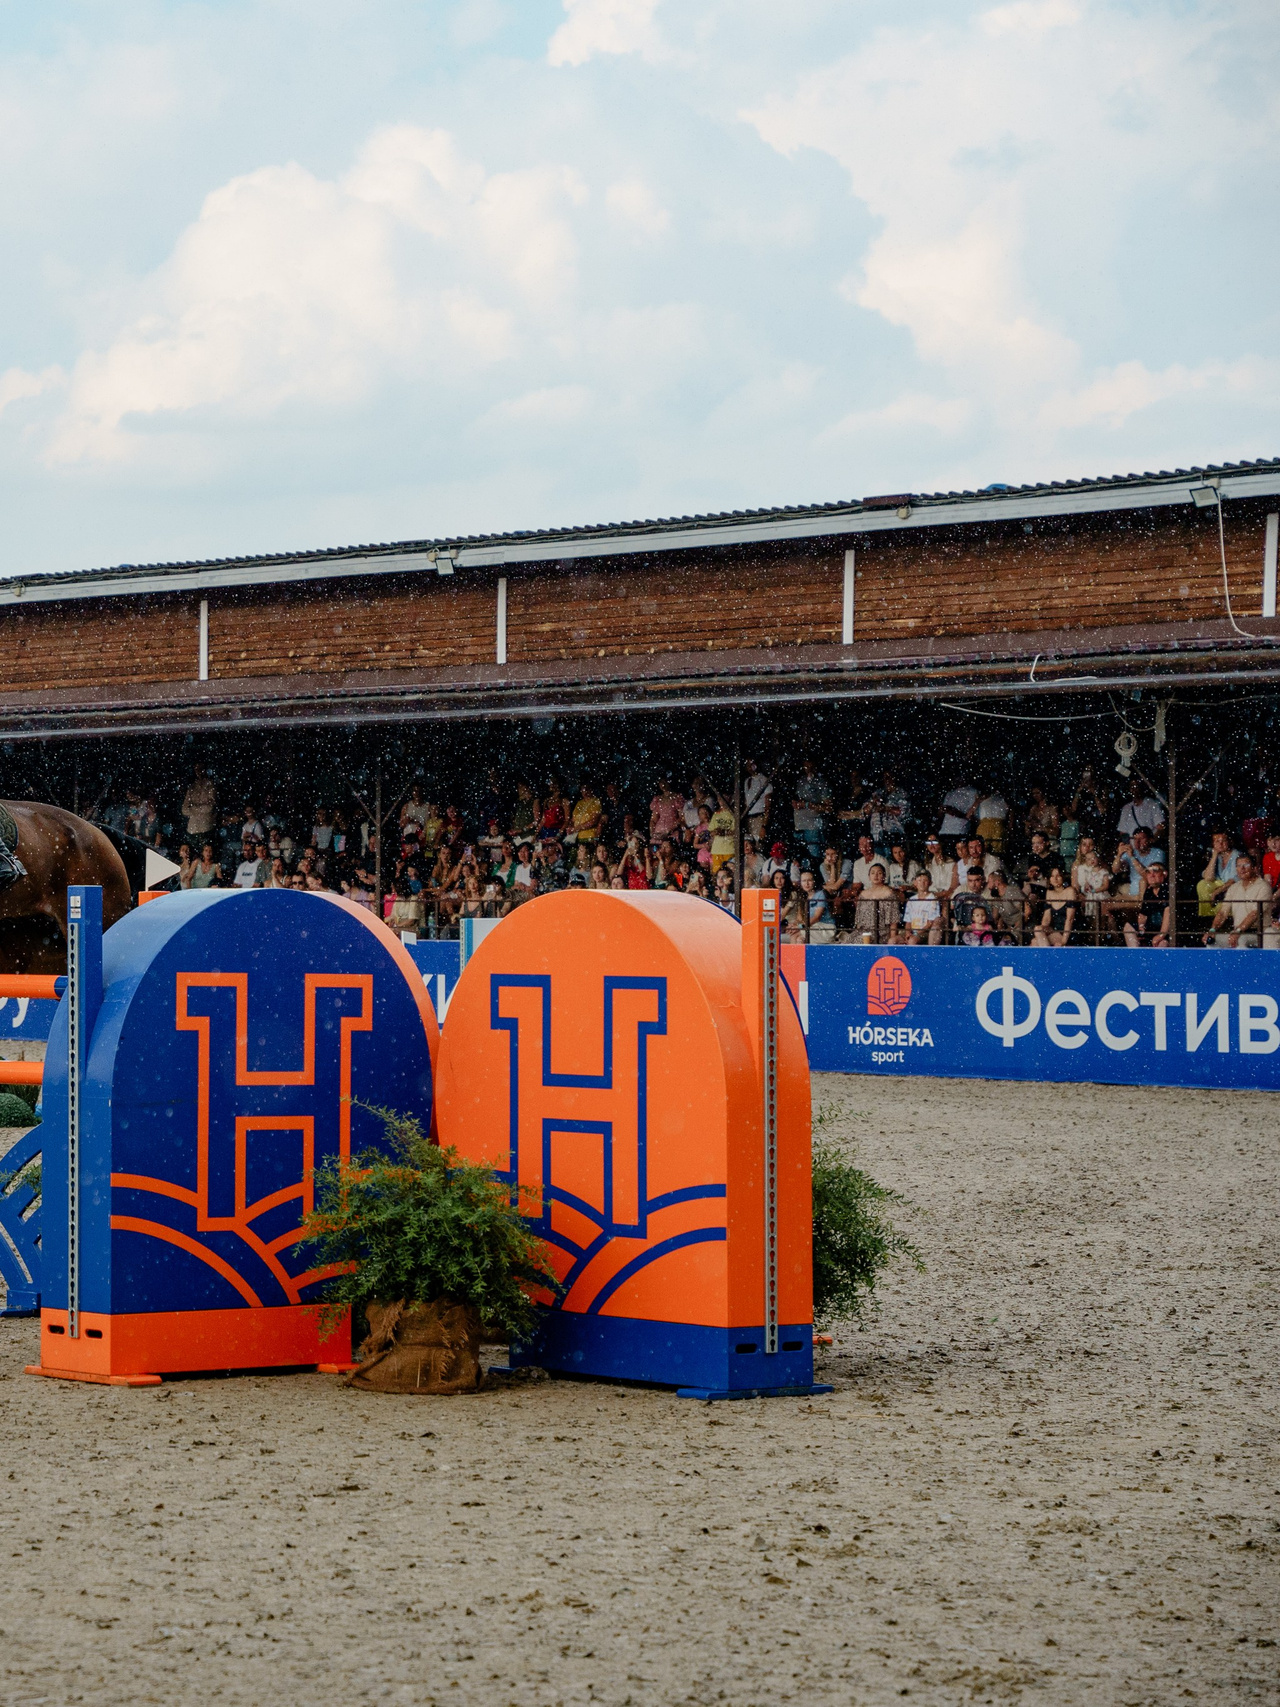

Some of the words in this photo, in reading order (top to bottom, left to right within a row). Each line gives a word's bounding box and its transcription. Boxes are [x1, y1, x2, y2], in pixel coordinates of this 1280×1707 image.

[975, 966, 1280, 1055] Фестив
[847, 1020, 935, 1048] HÓRSEKA
[871, 1050, 905, 1065] sport
